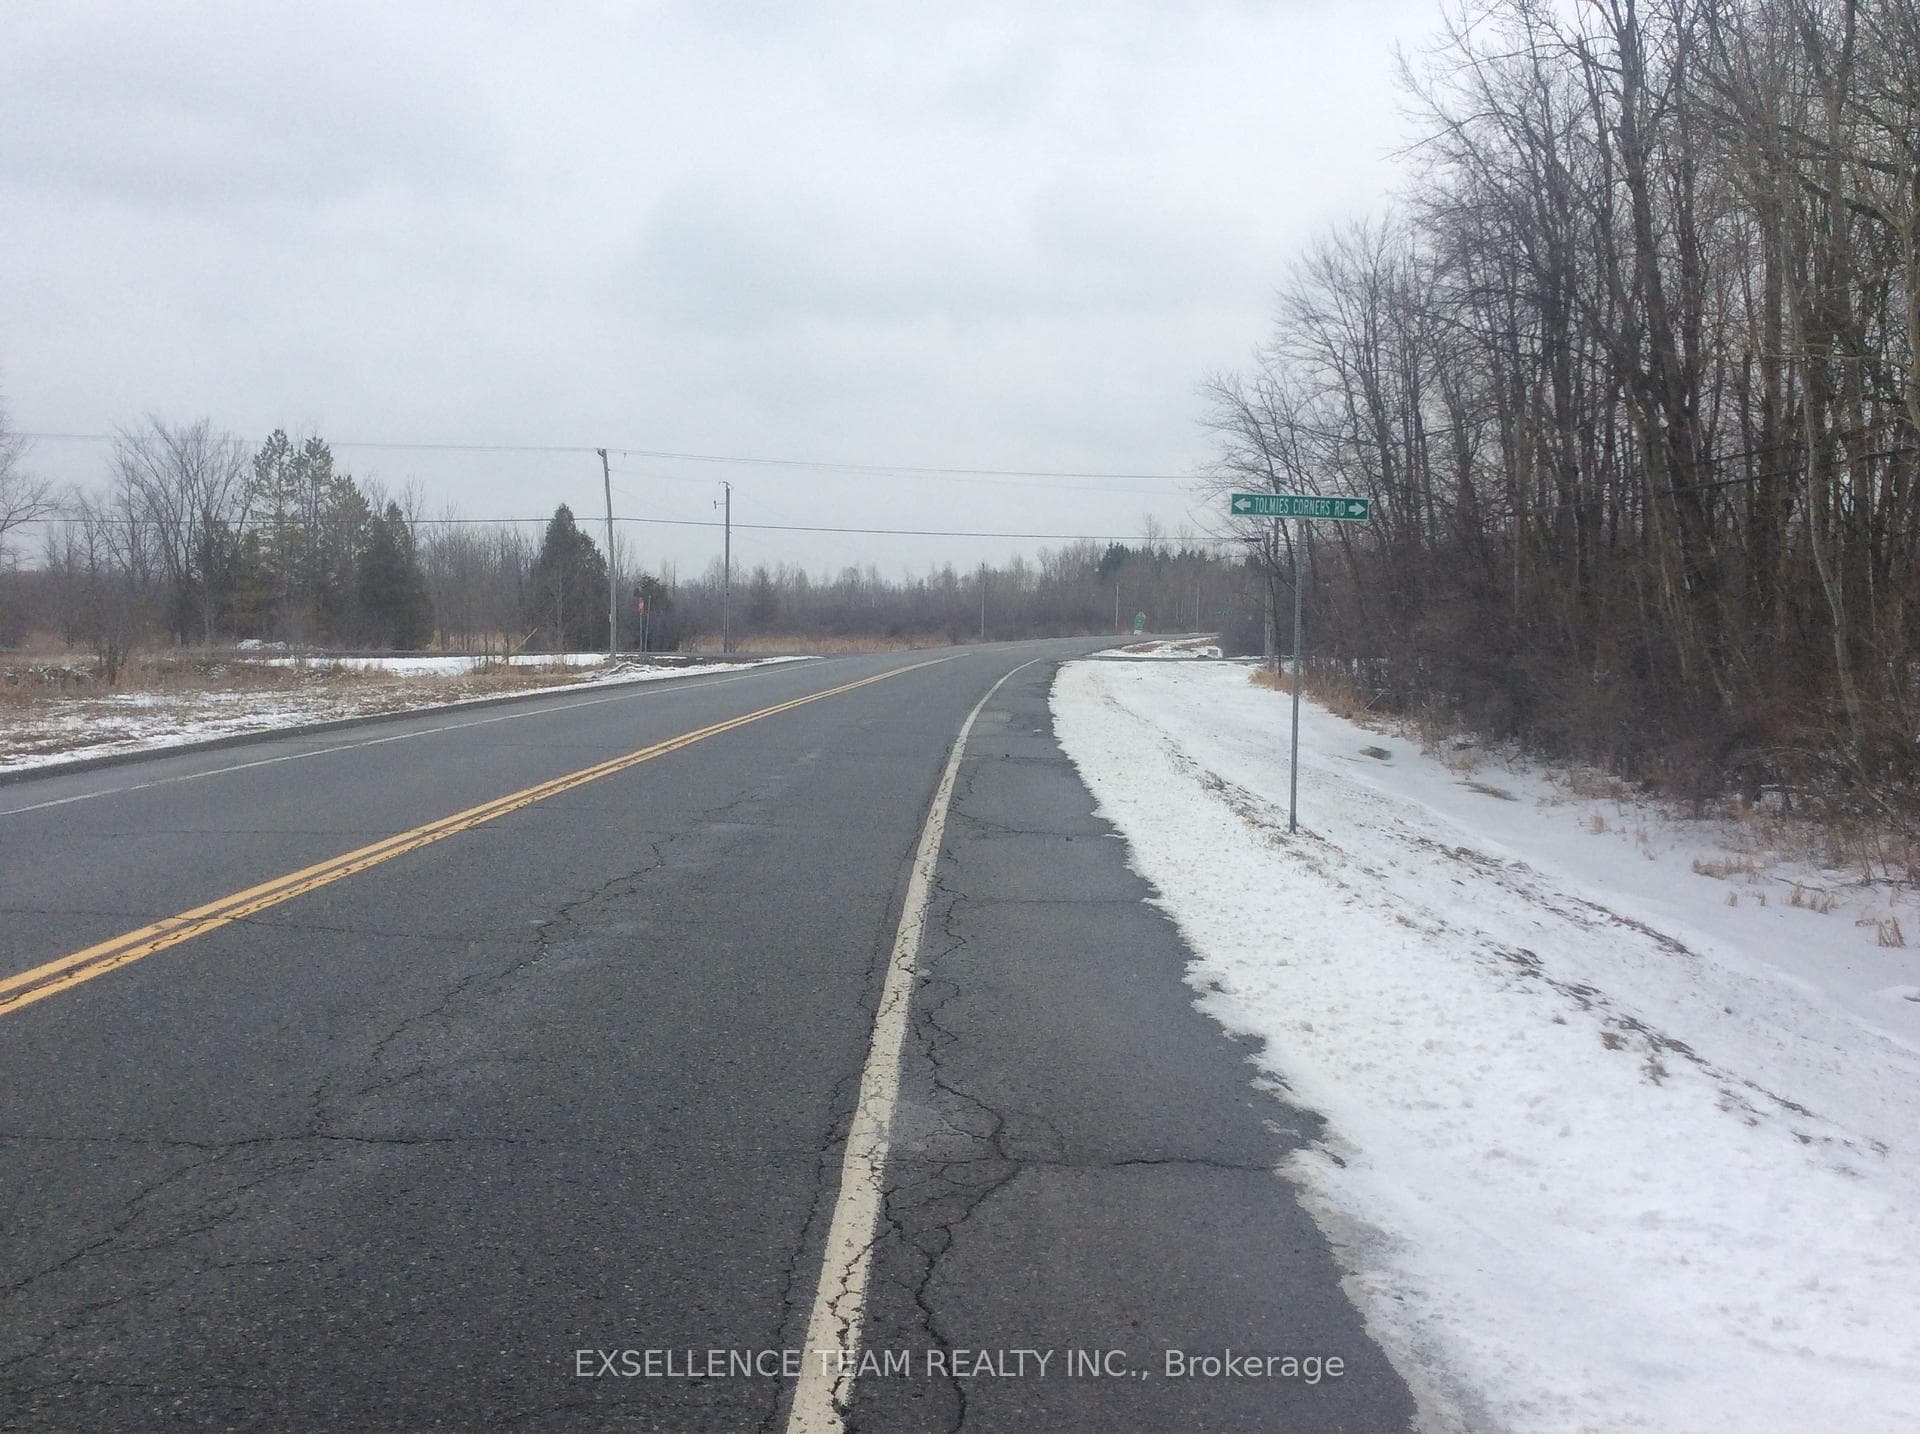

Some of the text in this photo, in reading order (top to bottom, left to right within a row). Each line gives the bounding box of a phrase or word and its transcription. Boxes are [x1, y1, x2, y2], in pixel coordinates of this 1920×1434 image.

[1254, 497, 1346, 516] TOLMIES CORNERS RD
